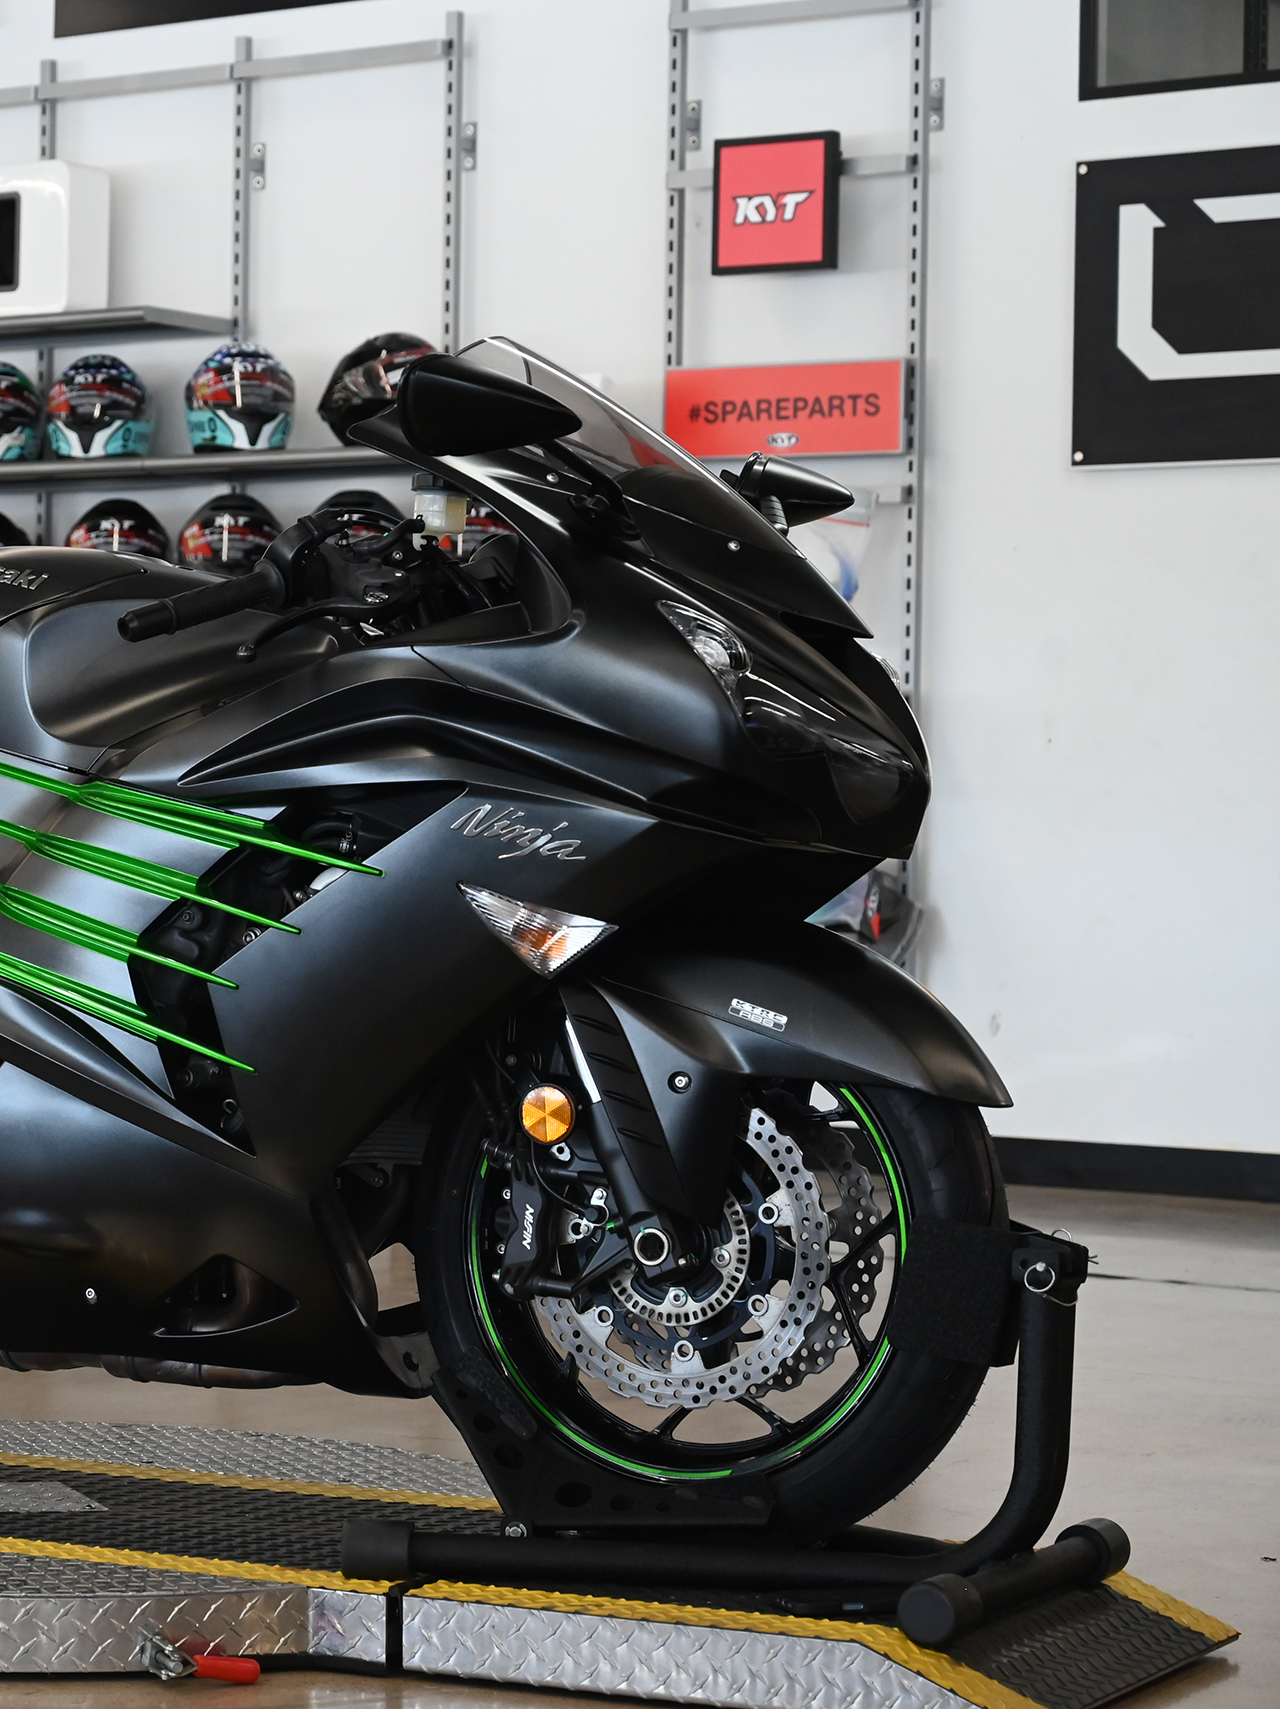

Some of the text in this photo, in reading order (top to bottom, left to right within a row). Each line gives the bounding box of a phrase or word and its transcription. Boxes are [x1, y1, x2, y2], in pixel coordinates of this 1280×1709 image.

[732, 189, 816, 226] KYT
[688, 393, 881, 424] #SPAREPARTS
[450, 803, 587, 861] Ninja
